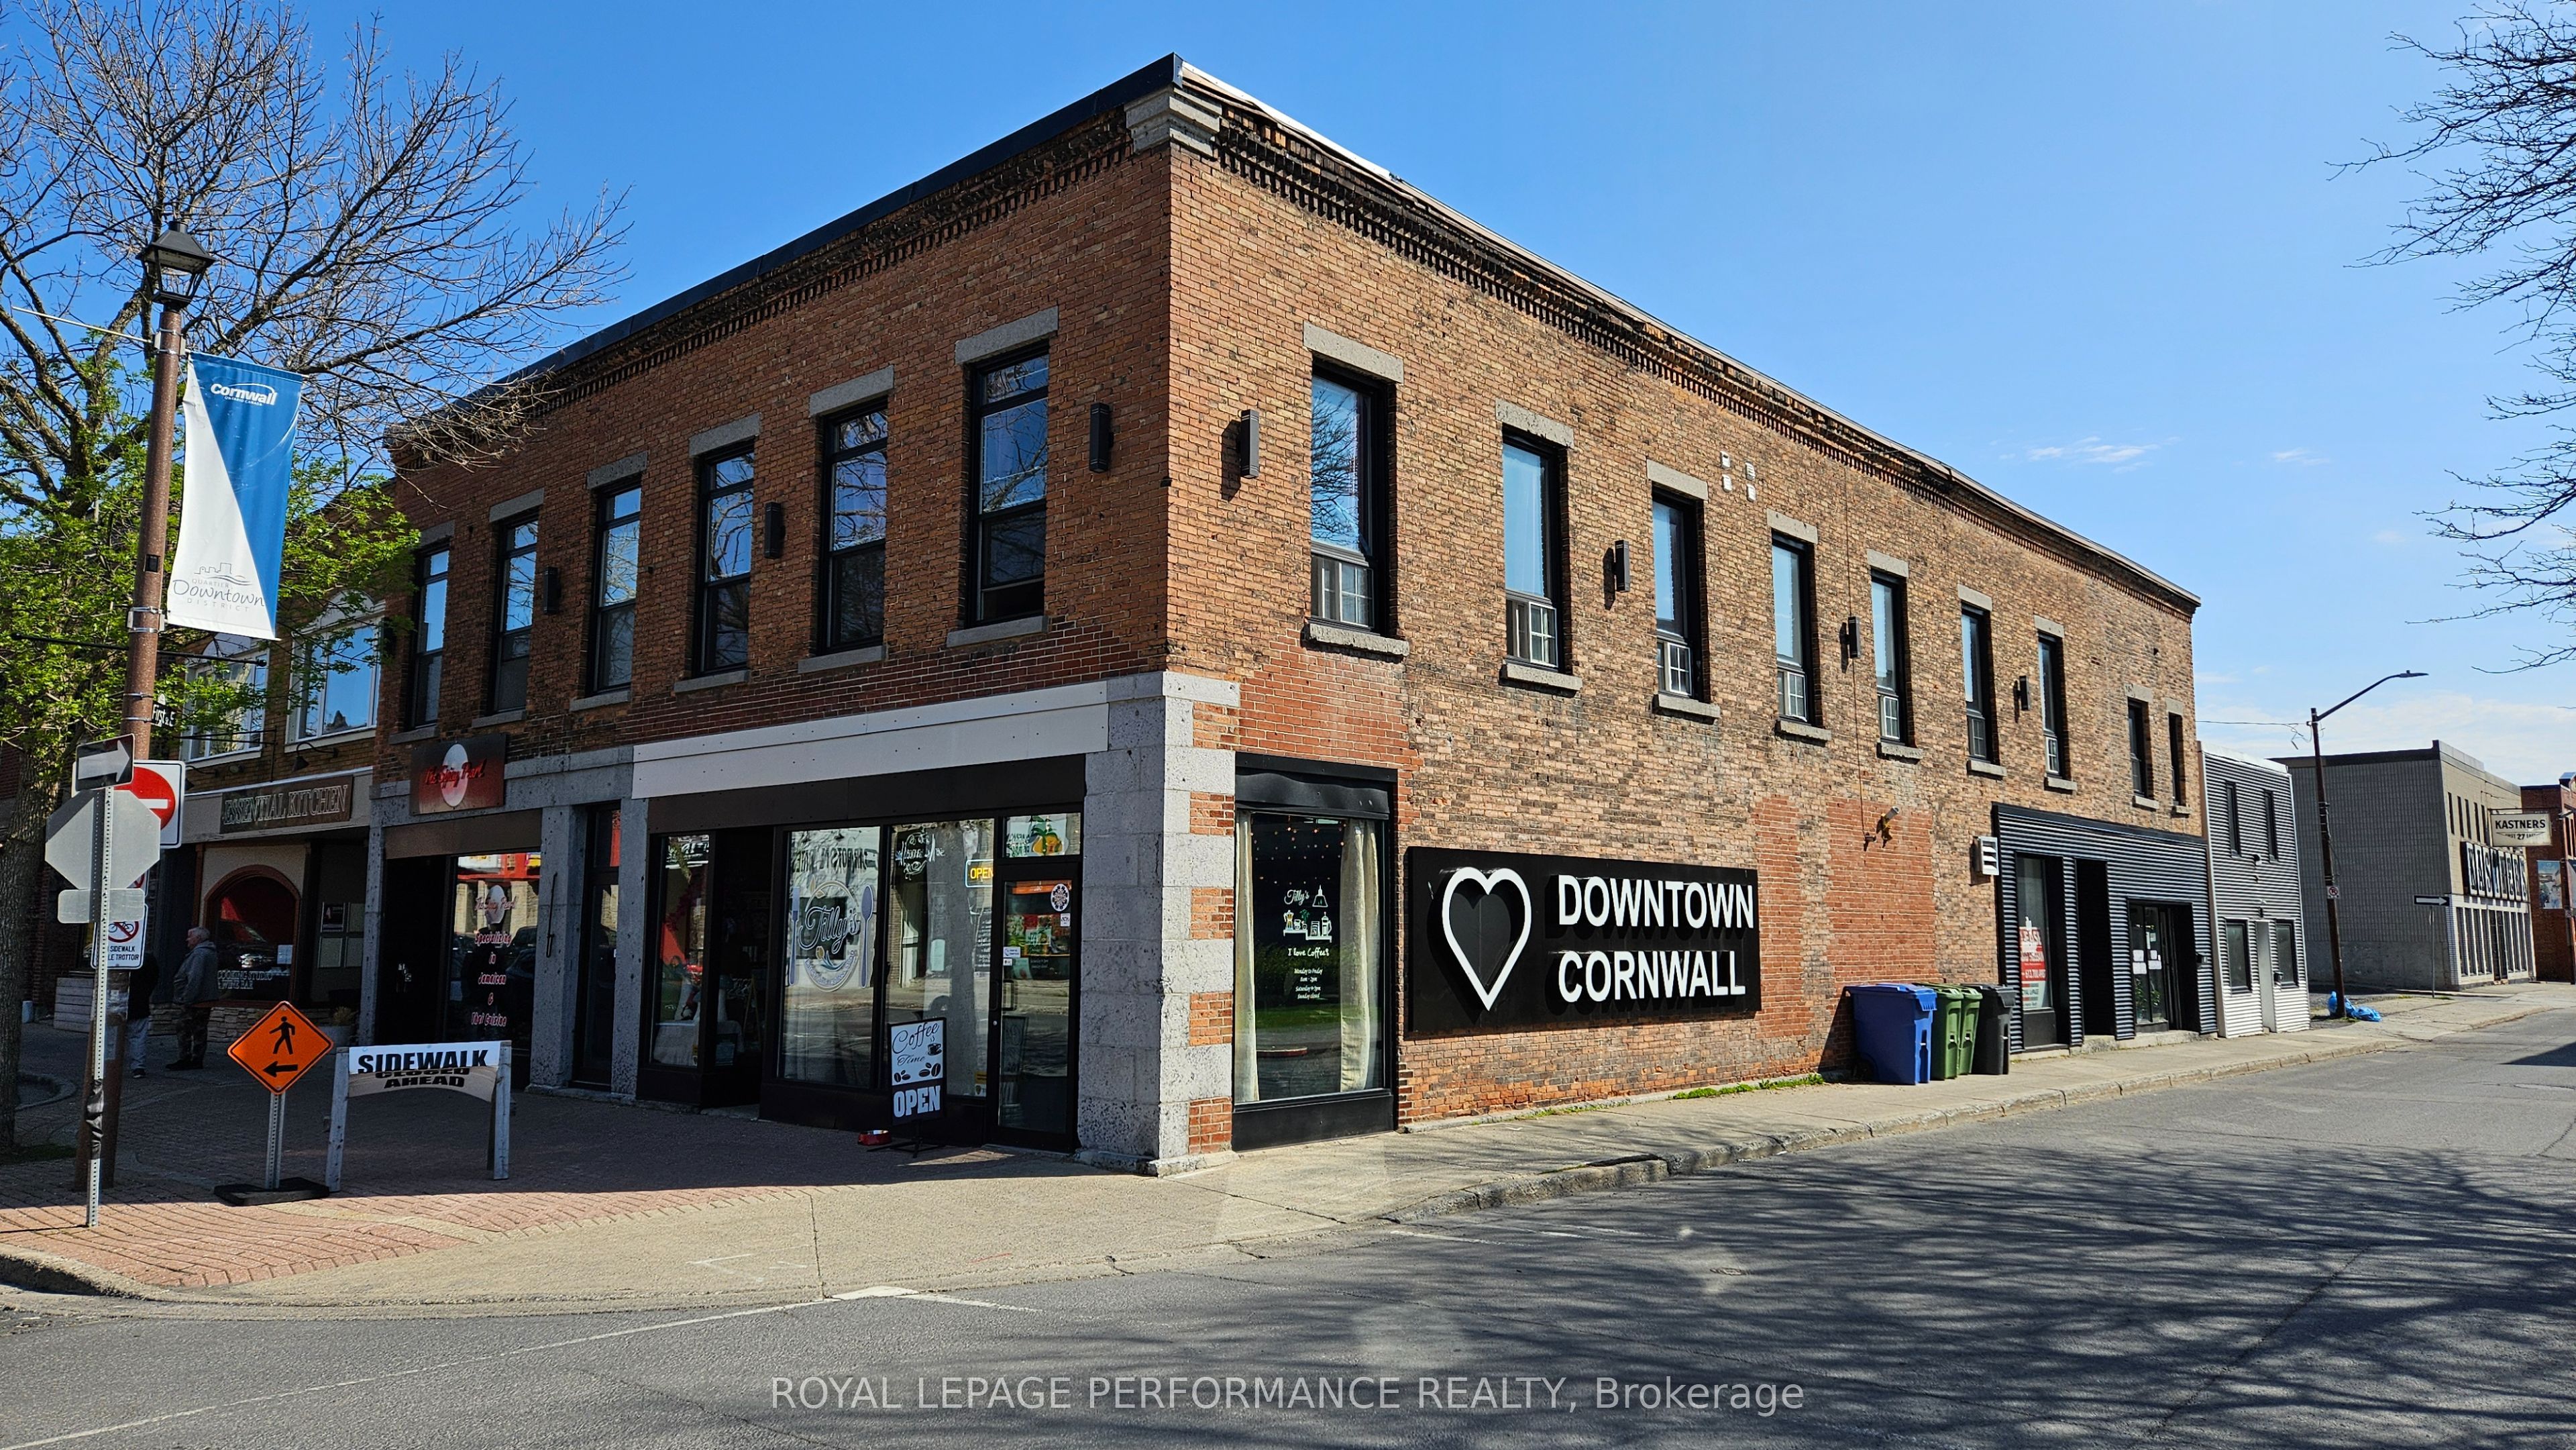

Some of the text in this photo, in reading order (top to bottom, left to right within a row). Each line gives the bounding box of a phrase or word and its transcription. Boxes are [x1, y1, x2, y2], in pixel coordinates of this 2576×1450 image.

[211, 383, 277, 405] Cornwall
[192, 578, 229, 588] QUARTIER
[172, 579, 264, 607] Downtown
[187, 598, 250, 612] DISTRICT
[223, 784, 348, 825] ESSENTIAL KITCHEN
[2495, 819, 2546, 829] KASTNERS
[970, 868, 994, 879] OPEN
[1284, 889, 1309, 906] Tilly's
[1558, 874, 1754, 929] DOWNTOWN
[798, 904, 860, 954] Tilly's
[475, 931, 512, 947] Specializing
[488, 951, 496, 964] in
[1287, 948, 1292, 956] I
[1293, 947, 1306, 956] love
[478, 972, 506, 985] Jamaican
[1558, 951, 1746, 1002] CORNWALL
[471, 1012, 484, 1025] Thai
[892, 1022, 939, 1054] Coffee
[358, 1049, 488, 1074] SIDEWALK
[897, 1054, 925, 1066] Time
[384, 1076, 465, 1088] AHEAD
[893, 1085, 941, 1118] OPEN
